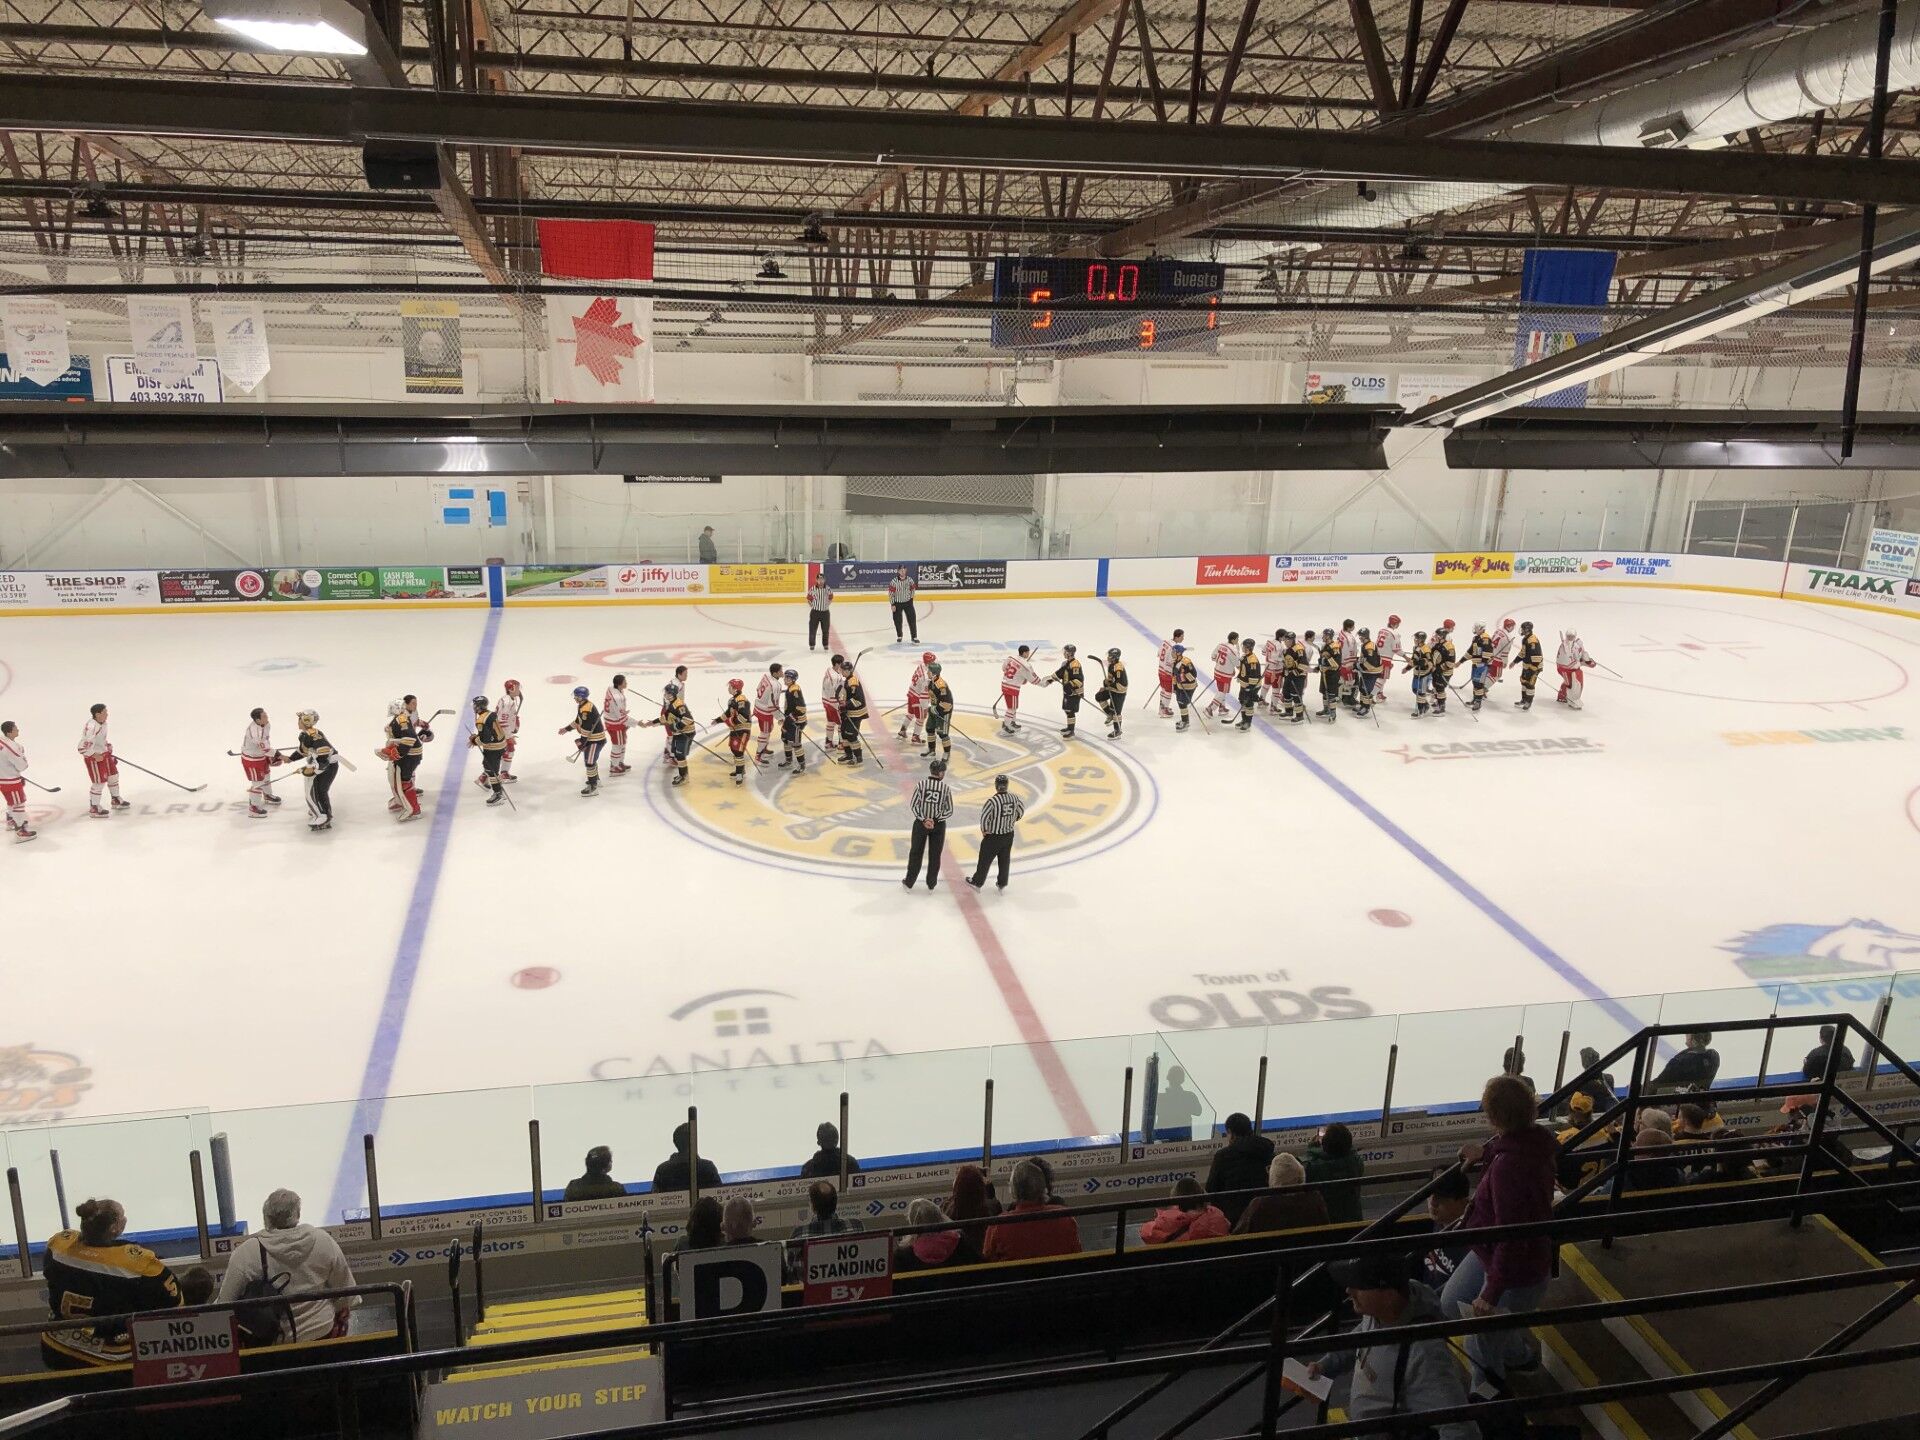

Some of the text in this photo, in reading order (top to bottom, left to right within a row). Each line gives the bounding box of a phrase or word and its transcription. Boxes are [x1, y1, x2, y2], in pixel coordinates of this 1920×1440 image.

[1012, 266, 1048, 284] Home
[1087, 264, 1139, 301] 0.0
[1174, 270, 1218, 287] Guests
[1031, 288, 1052, 329] 5
[1206, 296, 1217, 330] 1
[1140, 319, 1156, 347] 3
[1352, 377, 1386, 388] OLDS
[130, 391, 204, 402] 403.392.3870
[1874, 530, 1901, 538] SUPPORT
[1870, 542, 1916, 557] RONA
[918, 565, 938, 573] FAST
[1435, 559, 1510, 575] Booster Juice
[1648, 558, 1672, 567] SNIPE.
[383, 571, 415, 579] CASH FOR
[641, 567, 699, 583] jiffy lube
[758, 567, 796, 575] SHOP
[918, 572, 945, 580] HORSE
[1204, 564, 1260, 577] Tim Hortons
[1625, 566, 1657, 575] SELTZER.
[46, 576, 126, 586] TIRE SHOP
[328, 579, 358, 587] Hearing
[384, 578, 427, 587] SCRAP METAL
[1808, 569, 1904, 595] TRAXX
[1821, 586, 1897, 604] Travel Like The Pros
[618, 650, 786, 665] A&W
[1422, 737, 1594, 755] CARSTAR
[925, 791, 940, 803] 29
[1002, 804, 1014, 816] 95
[1193, 969, 1291, 986] Town of
[1150, 985, 1373, 1029] OLDS
[588, 1037, 897, 1081] CANALTA
[1405, 1117, 1476, 1130] COLDWELL BANKER
[1146, 1142, 1223, 1156] COLDWELL BANKER
[1080, 1157, 1095, 1165] 507
[868, 1168, 950, 1184] COLDWELL BANKER
[1105, 1170, 1197, 1189] co-operators
[777, 1188, 793, 1196] 403
[565, 1198, 654, 1214] COLDWELL BANKER
[660, 1199, 685, 1207] REALTY
[416, 1217, 440, 1225] CAVIN
[486, 1215, 503, 1225] 507
[506, 1213, 528, 1223] 5335
[488, 1209, 523, 1218] COWLING
[389, 1222, 451, 1235] 403 415 9464
[578, 1234, 630, 1244] Financial Group
[416, 1240, 525, 1261] co-oeators
[837, 1243, 860, 1262] NO
[809, 1257, 887, 1281] STANDING
[831, 1283, 864, 1301] By
[168, 1320, 195, 1337] NO
[139, 1333, 230, 1356] STANDING
[166, 1361, 208, 1381] By
[436, 1383, 648, 1427] WATCH YOUR STEP
